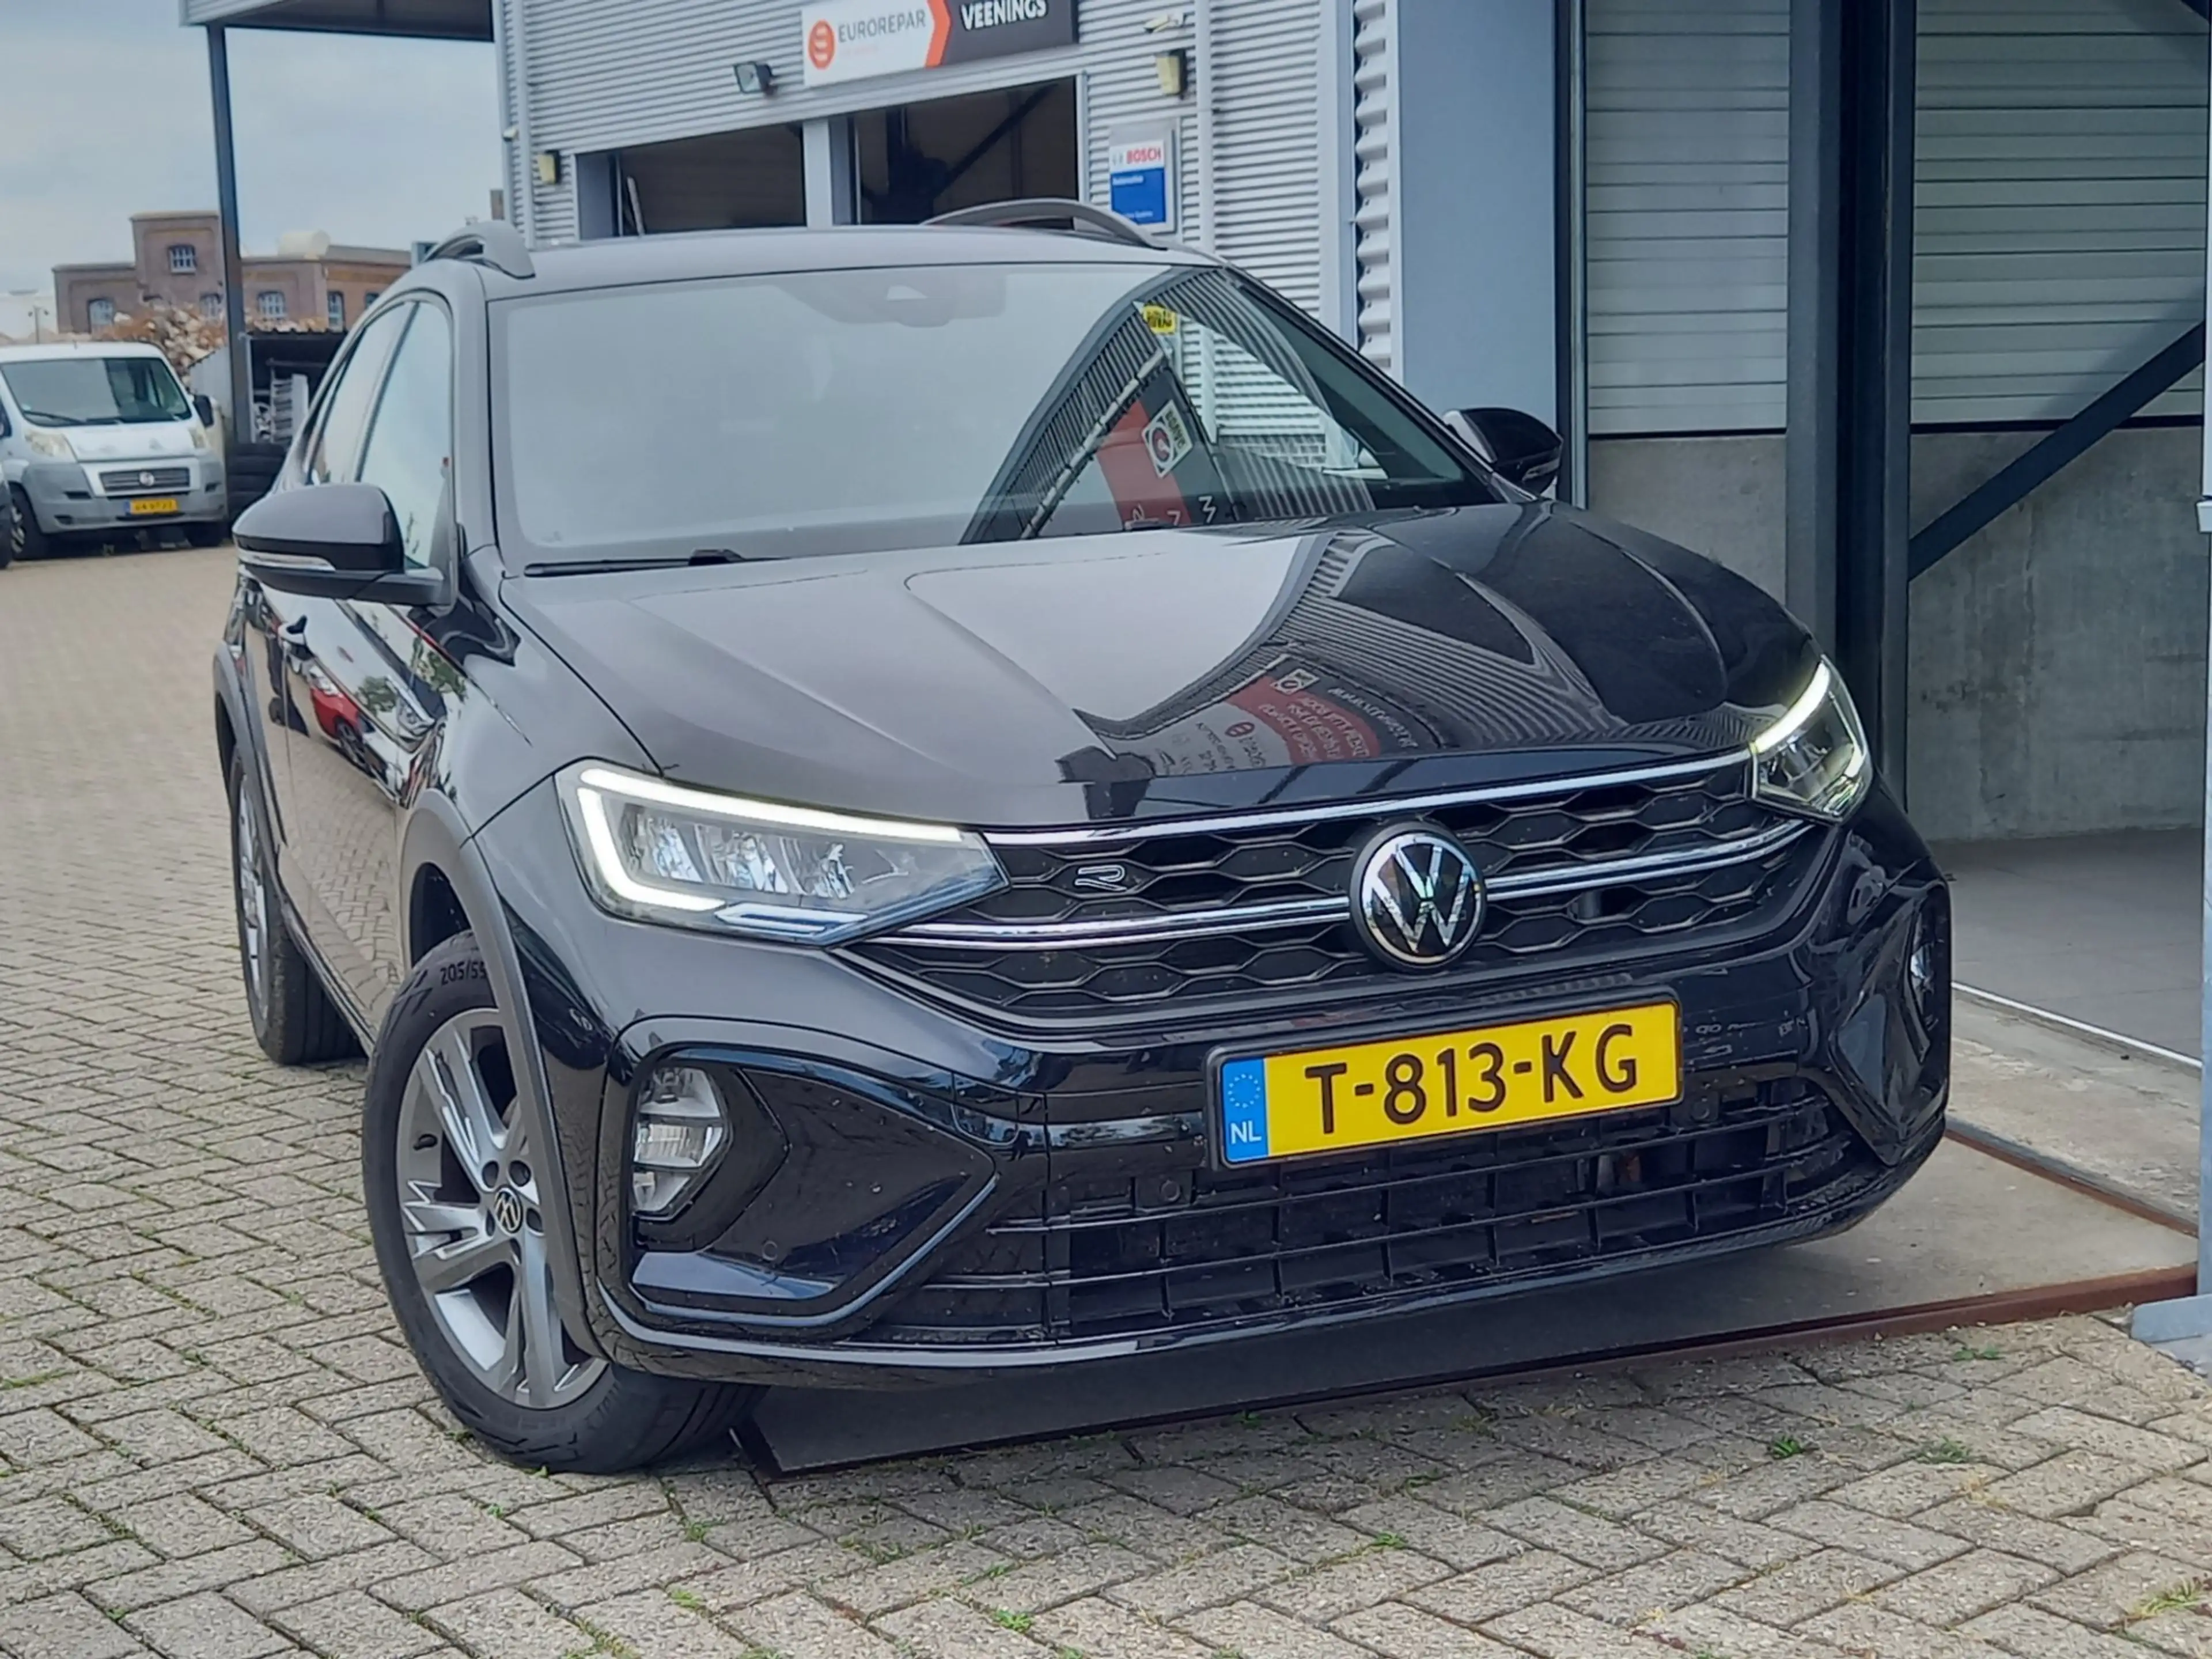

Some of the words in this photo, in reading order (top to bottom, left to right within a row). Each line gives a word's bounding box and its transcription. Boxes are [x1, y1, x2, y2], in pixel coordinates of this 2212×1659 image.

[838, 9, 926, 43] EUROREPAR
[961, 0, 1047, 30] VEENINGS
[1126, 147, 1162, 165] BOSCH
[1305, 1024, 1637, 1134] T-813-KG
[1230, 1121, 1262, 1145] NL
